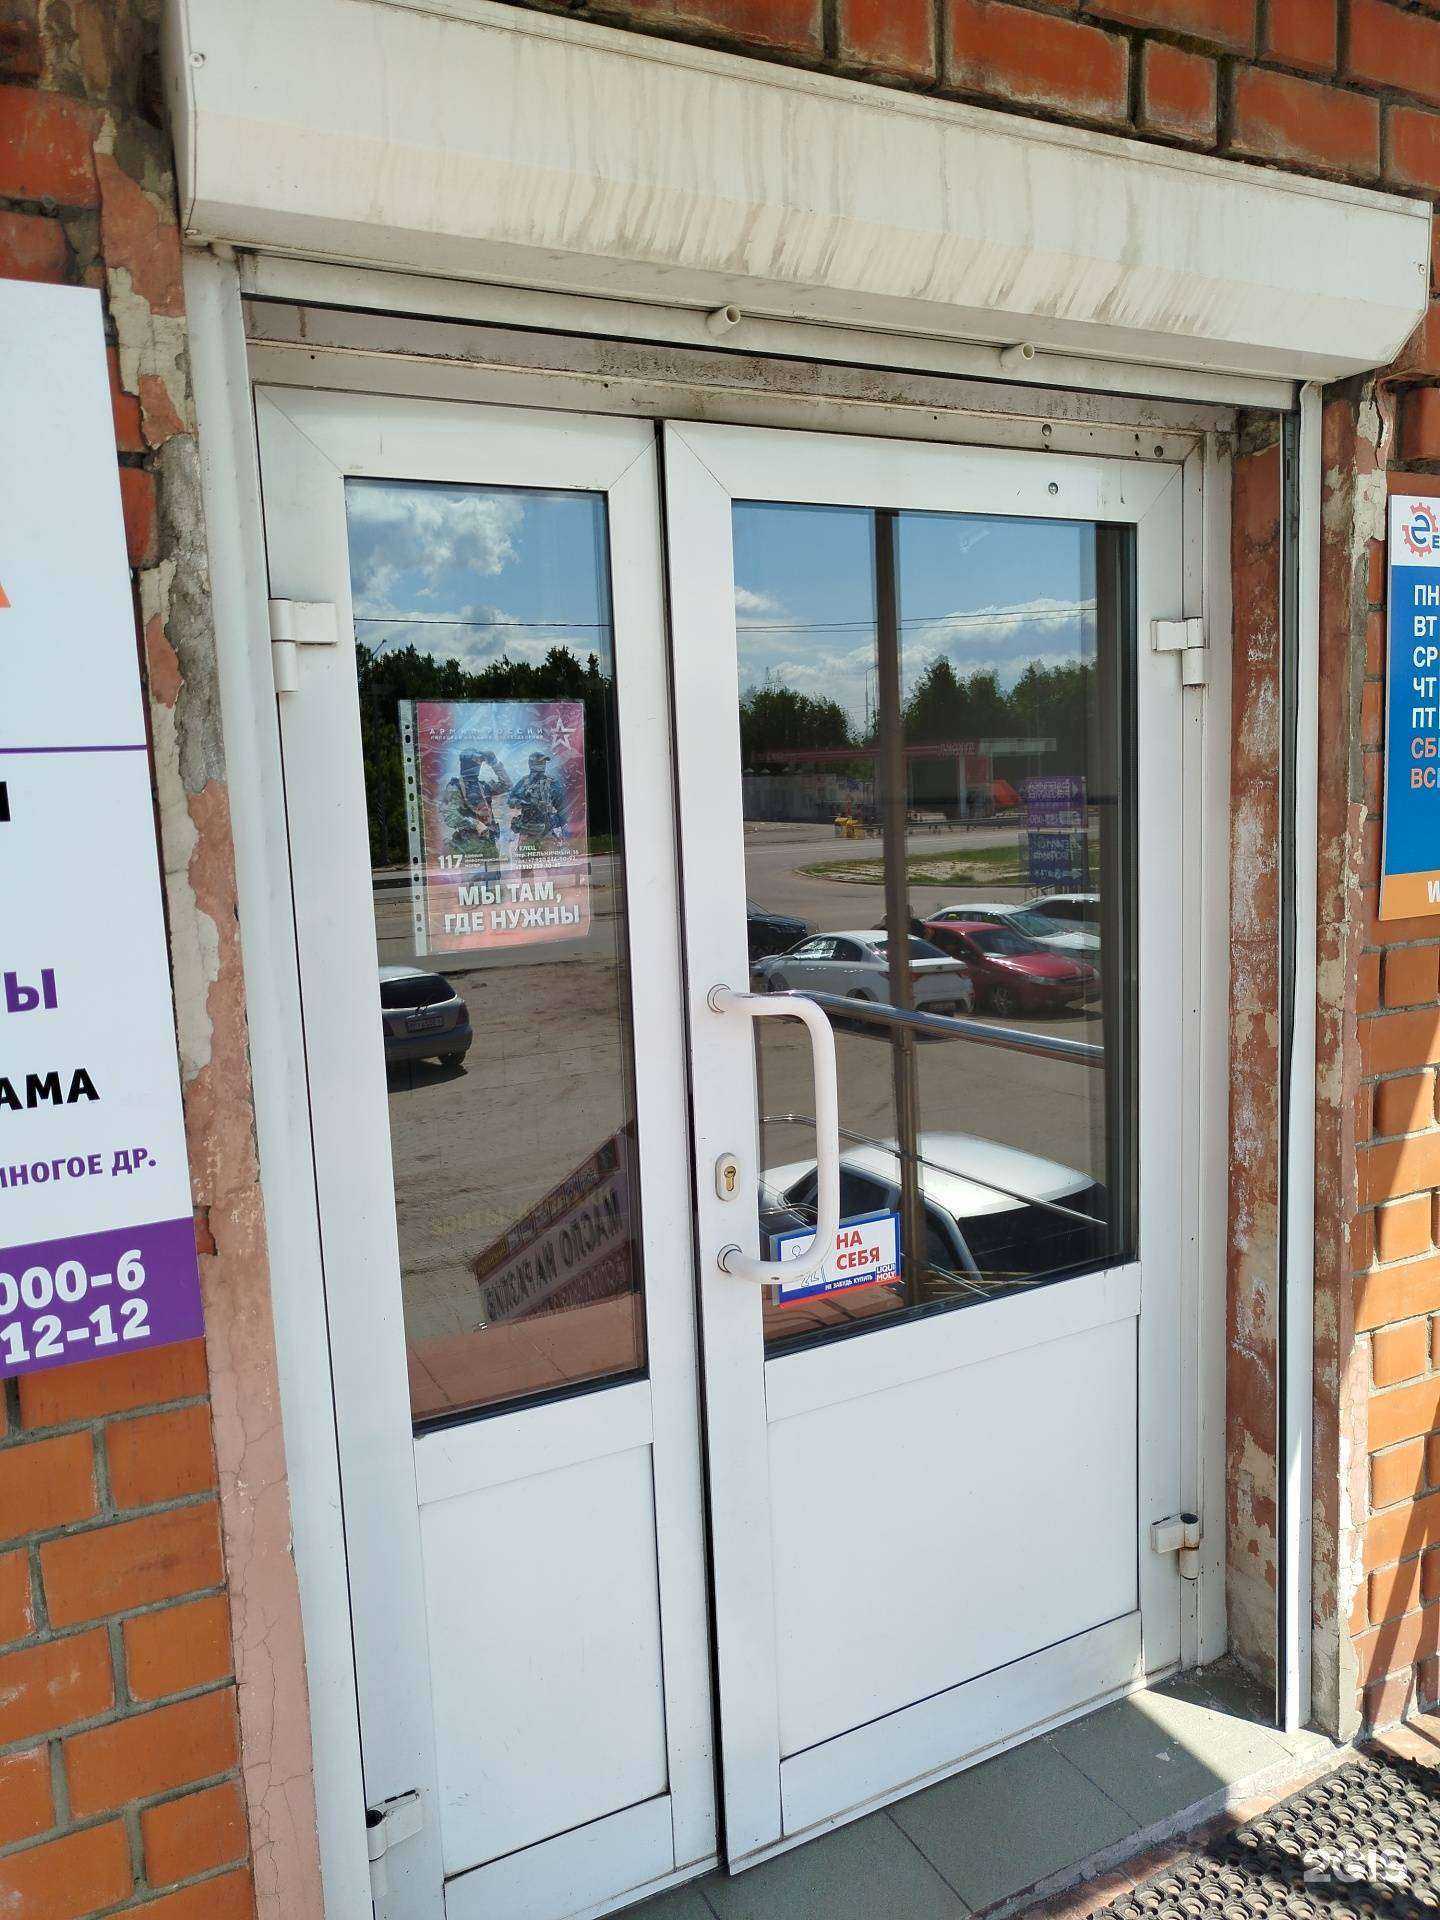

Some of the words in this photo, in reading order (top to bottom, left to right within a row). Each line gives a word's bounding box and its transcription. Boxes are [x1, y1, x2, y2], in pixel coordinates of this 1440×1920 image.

[1413, 584, 1440, 606] ПН
[1413, 615, 1438, 637] ВТ
[1413, 646, 1438, 668] СР
[1412, 676, 1437, 698] ЧТ
[1411, 707, 1437, 729] ПТ
[1411, 737, 1438, 759] СБ
[1410, 766, 1437, 789] ВС
[437, 853, 463, 870] 117
[458, 884, 501, 906] МЫ
[506, 881, 562, 903] ТАМ,
[444, 911, 484, 935] ГДЕ
[491, 904, 580, 930] НУЖНЫ
[111, 1147, 157, 1176] ДР.
[836, 1230, 863, 1250] НА
[836, 1247, 880, 1270] СЕБЯ
[876, 1263, 897, 1274] LIQUI
[833, 1278, 853, 1289] ЗАБУДЬ
[853, 1274, 874, 1284] КУПИТЬ
[876, 1271, 897, 1283] MOLY
[0, 1298, 150, 1364] 12-12
